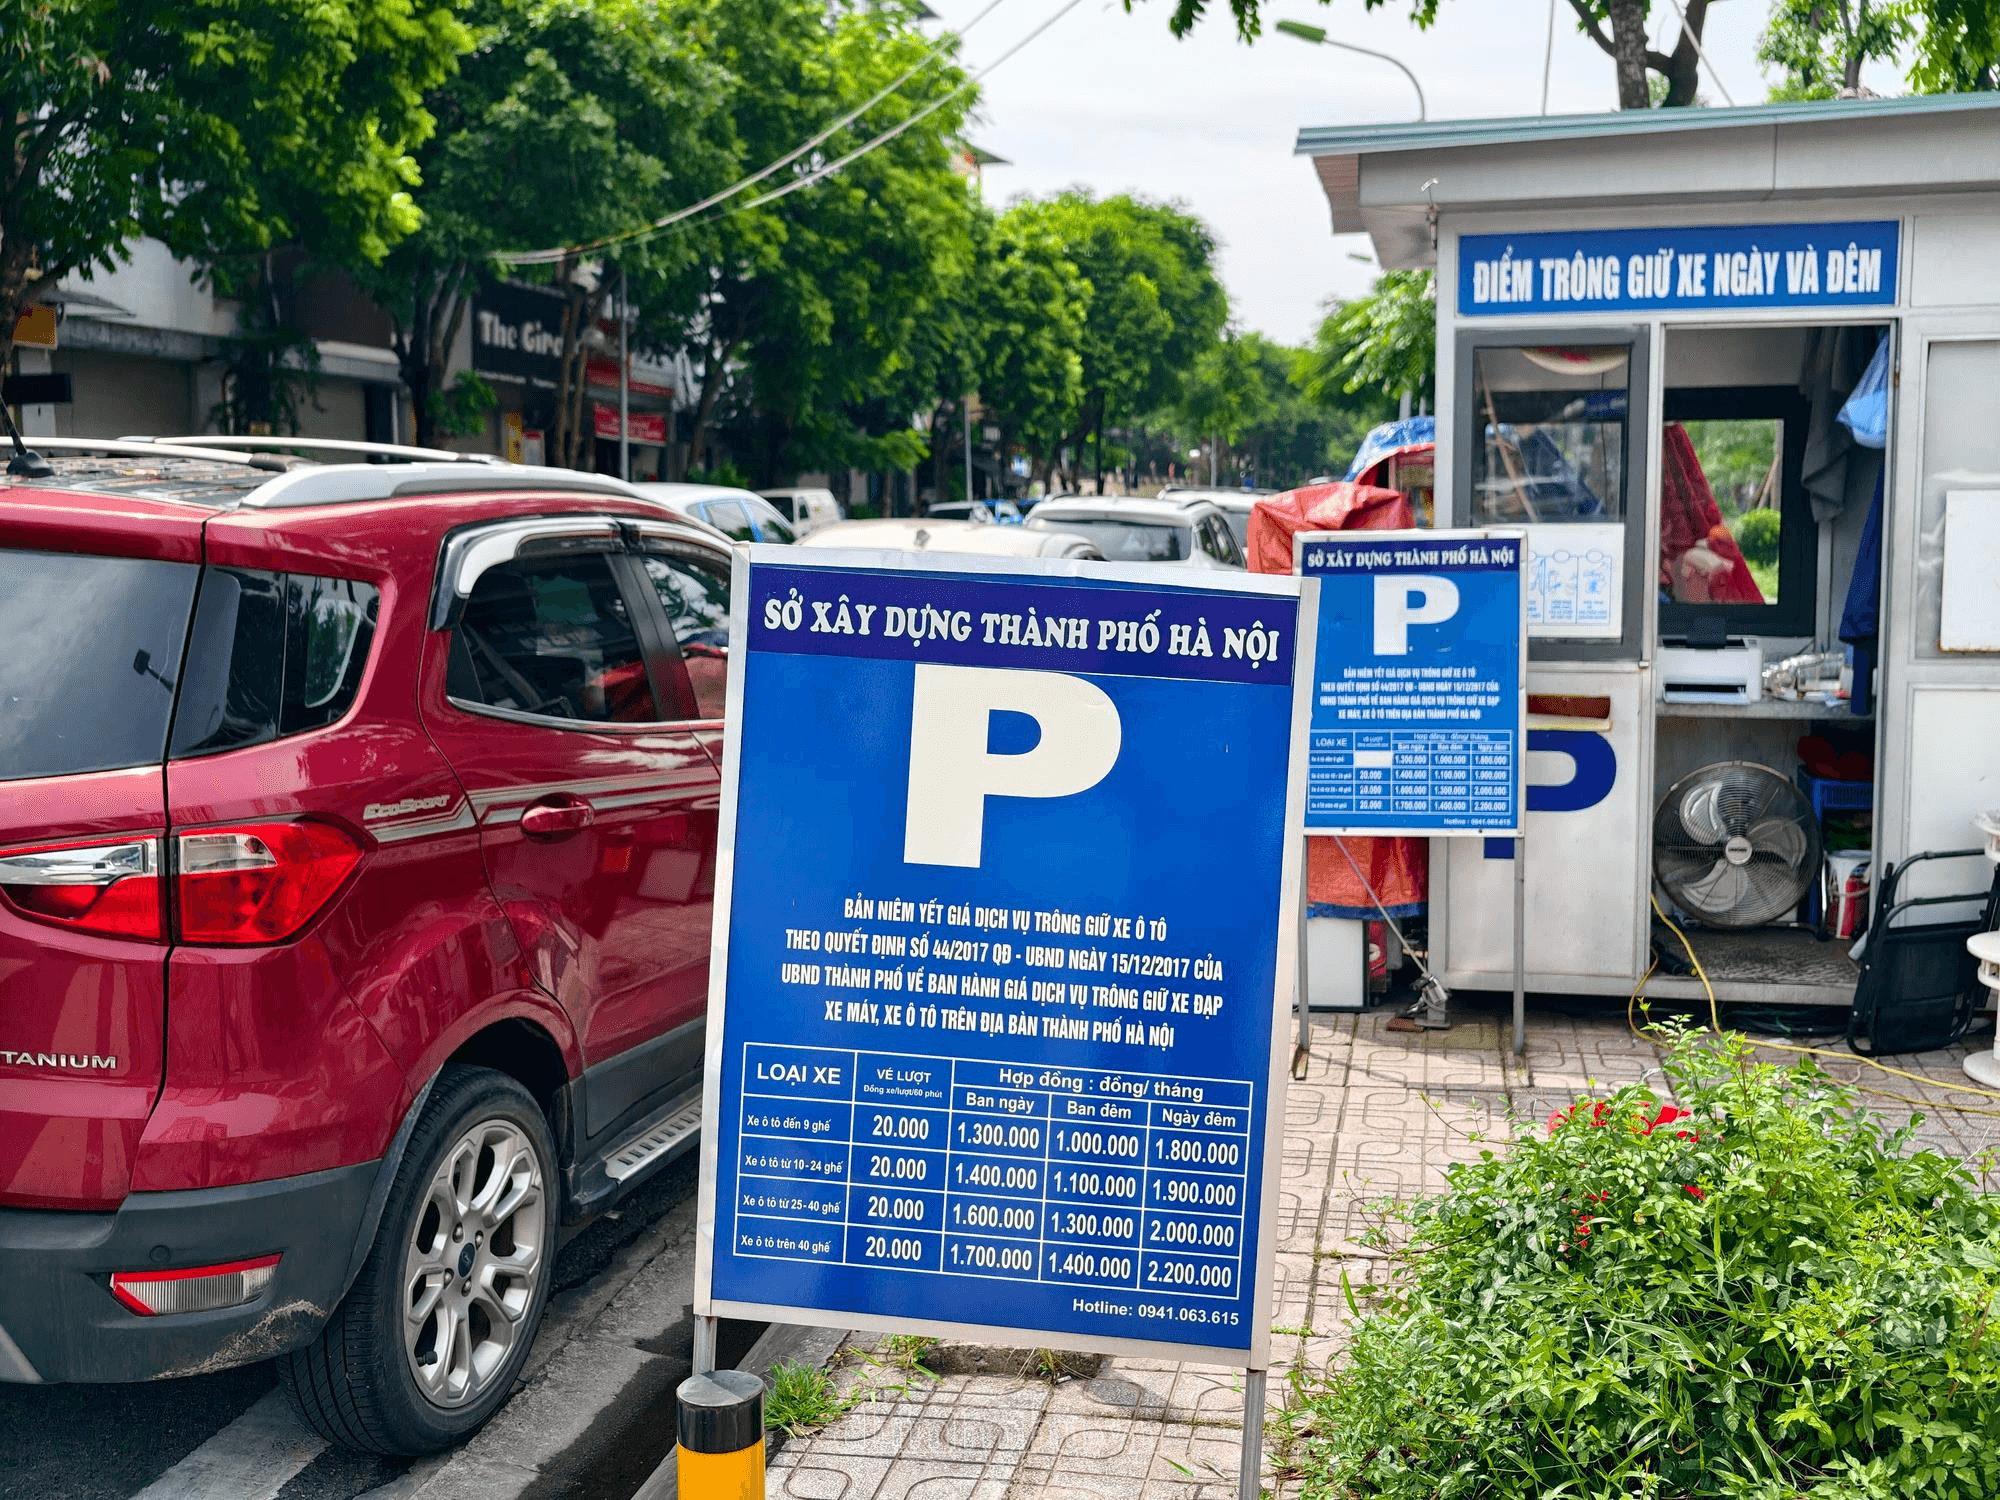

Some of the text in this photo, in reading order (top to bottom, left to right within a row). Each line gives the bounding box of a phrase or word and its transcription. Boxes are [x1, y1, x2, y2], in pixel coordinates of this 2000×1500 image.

[1473, 241, 1882, 303] ĐIỂM TRÔNG GIỮ XE NGÀY VÀ ĐÊM
[478, 309, 518, 349] The
[1308, 545, 1514, 570] SỞ XÂY DỰNG THÀNH PHỐ HÀ NỘI
[764, 587, 1280, 669] SỞ XÂY DỰNG THÀNH PHỐ HÀ NỘI
[1374, 574, 1460, 655] P
[903, 664, 1122, 869] P
[844, 892, 1167, 942] BẢN NIÊM YẾT GIÁ DỊCH VỤ TRÔNG GIỮ XE Ô TÔ
[785, 928, 821, 951] THEO
[824, 927, 869, 954] QUYẾT
[871, 934, 906, 960] ĐỊNH
[909, 931, 930, 958] SỐ
[932, 939, 989, 963] 44/2017
[992, 943, 1012, 966] QĐ
[1025, 945, 1065, 969] UBND
[1068, 946, 1108, 972] NGÀY
[1111, 952, 1191, 978] 15/12/2017
[1193, 953, 1223, 981] CỦA
[781, 962, 1223, 1020] UBND THÀNH PHỐ VỀ BAN HÀNH GIÁ DỊCH VỤ TRÔNG GIỮ XE ĐẠP
[824, 998, 1175, 1052] XE MÁY, XE Ô TÔ TRÊN ĐỊA BÀN THÀNH PHỐ HÀ NỘI
[0, 1050, 117, 1069] TANIUM
[757, 1062, 841, 1086] LOẠI XE
[876, 1067, 932, 1085] VÉ LƯỢT
[999, 1068, 1034, 1089] Hợp
[1039, 1070, 1083, 1092] đồng
[1099, 1075, 1149, 1097] đồng/
[1153, 1081, 1204, 1102] tháng
[966, 1091, 1035, 1117] Ban ngày
[1067, 1100, 1132, 1119] Ban đêm
[1160, 1108, 1236, 1131] Ngày đêm
[747, 1114, 831, 1134] Xe ô tô đến 9 ghế
[872, 1114, 1239, 1166] 20.000 1.300.000 1.000.000 1.800.000
[745, 1154, 758, 1167] Xe
[759, 1155, 767, 1167] ô
[768, 1156, 779, 1168] tô
[824, 1160, 844, 1175] ghế
[869, 1155, 1236, 1207] 20.000 1.400.000 1.100.000 1.900.000
[742, 1194, 756, 1207] Xe
[757, 1195, 765, 1207] ô
[766, 1196, 777, 1208] tô
[821, 1201, 841, 1215] ghế
[867, 1195, 1235, 1247] 20.000 1.600.000 1.300.000 2.000.000
[740, 1234, 832, 1255] Xe ô tô trên 40 ghế
[865, 1235, 1232, 1289] 20.000 1.700.000 1.400.000 2.200.000
[1072, 1298, 1239, 1326] Hotline: 0941.063.615
